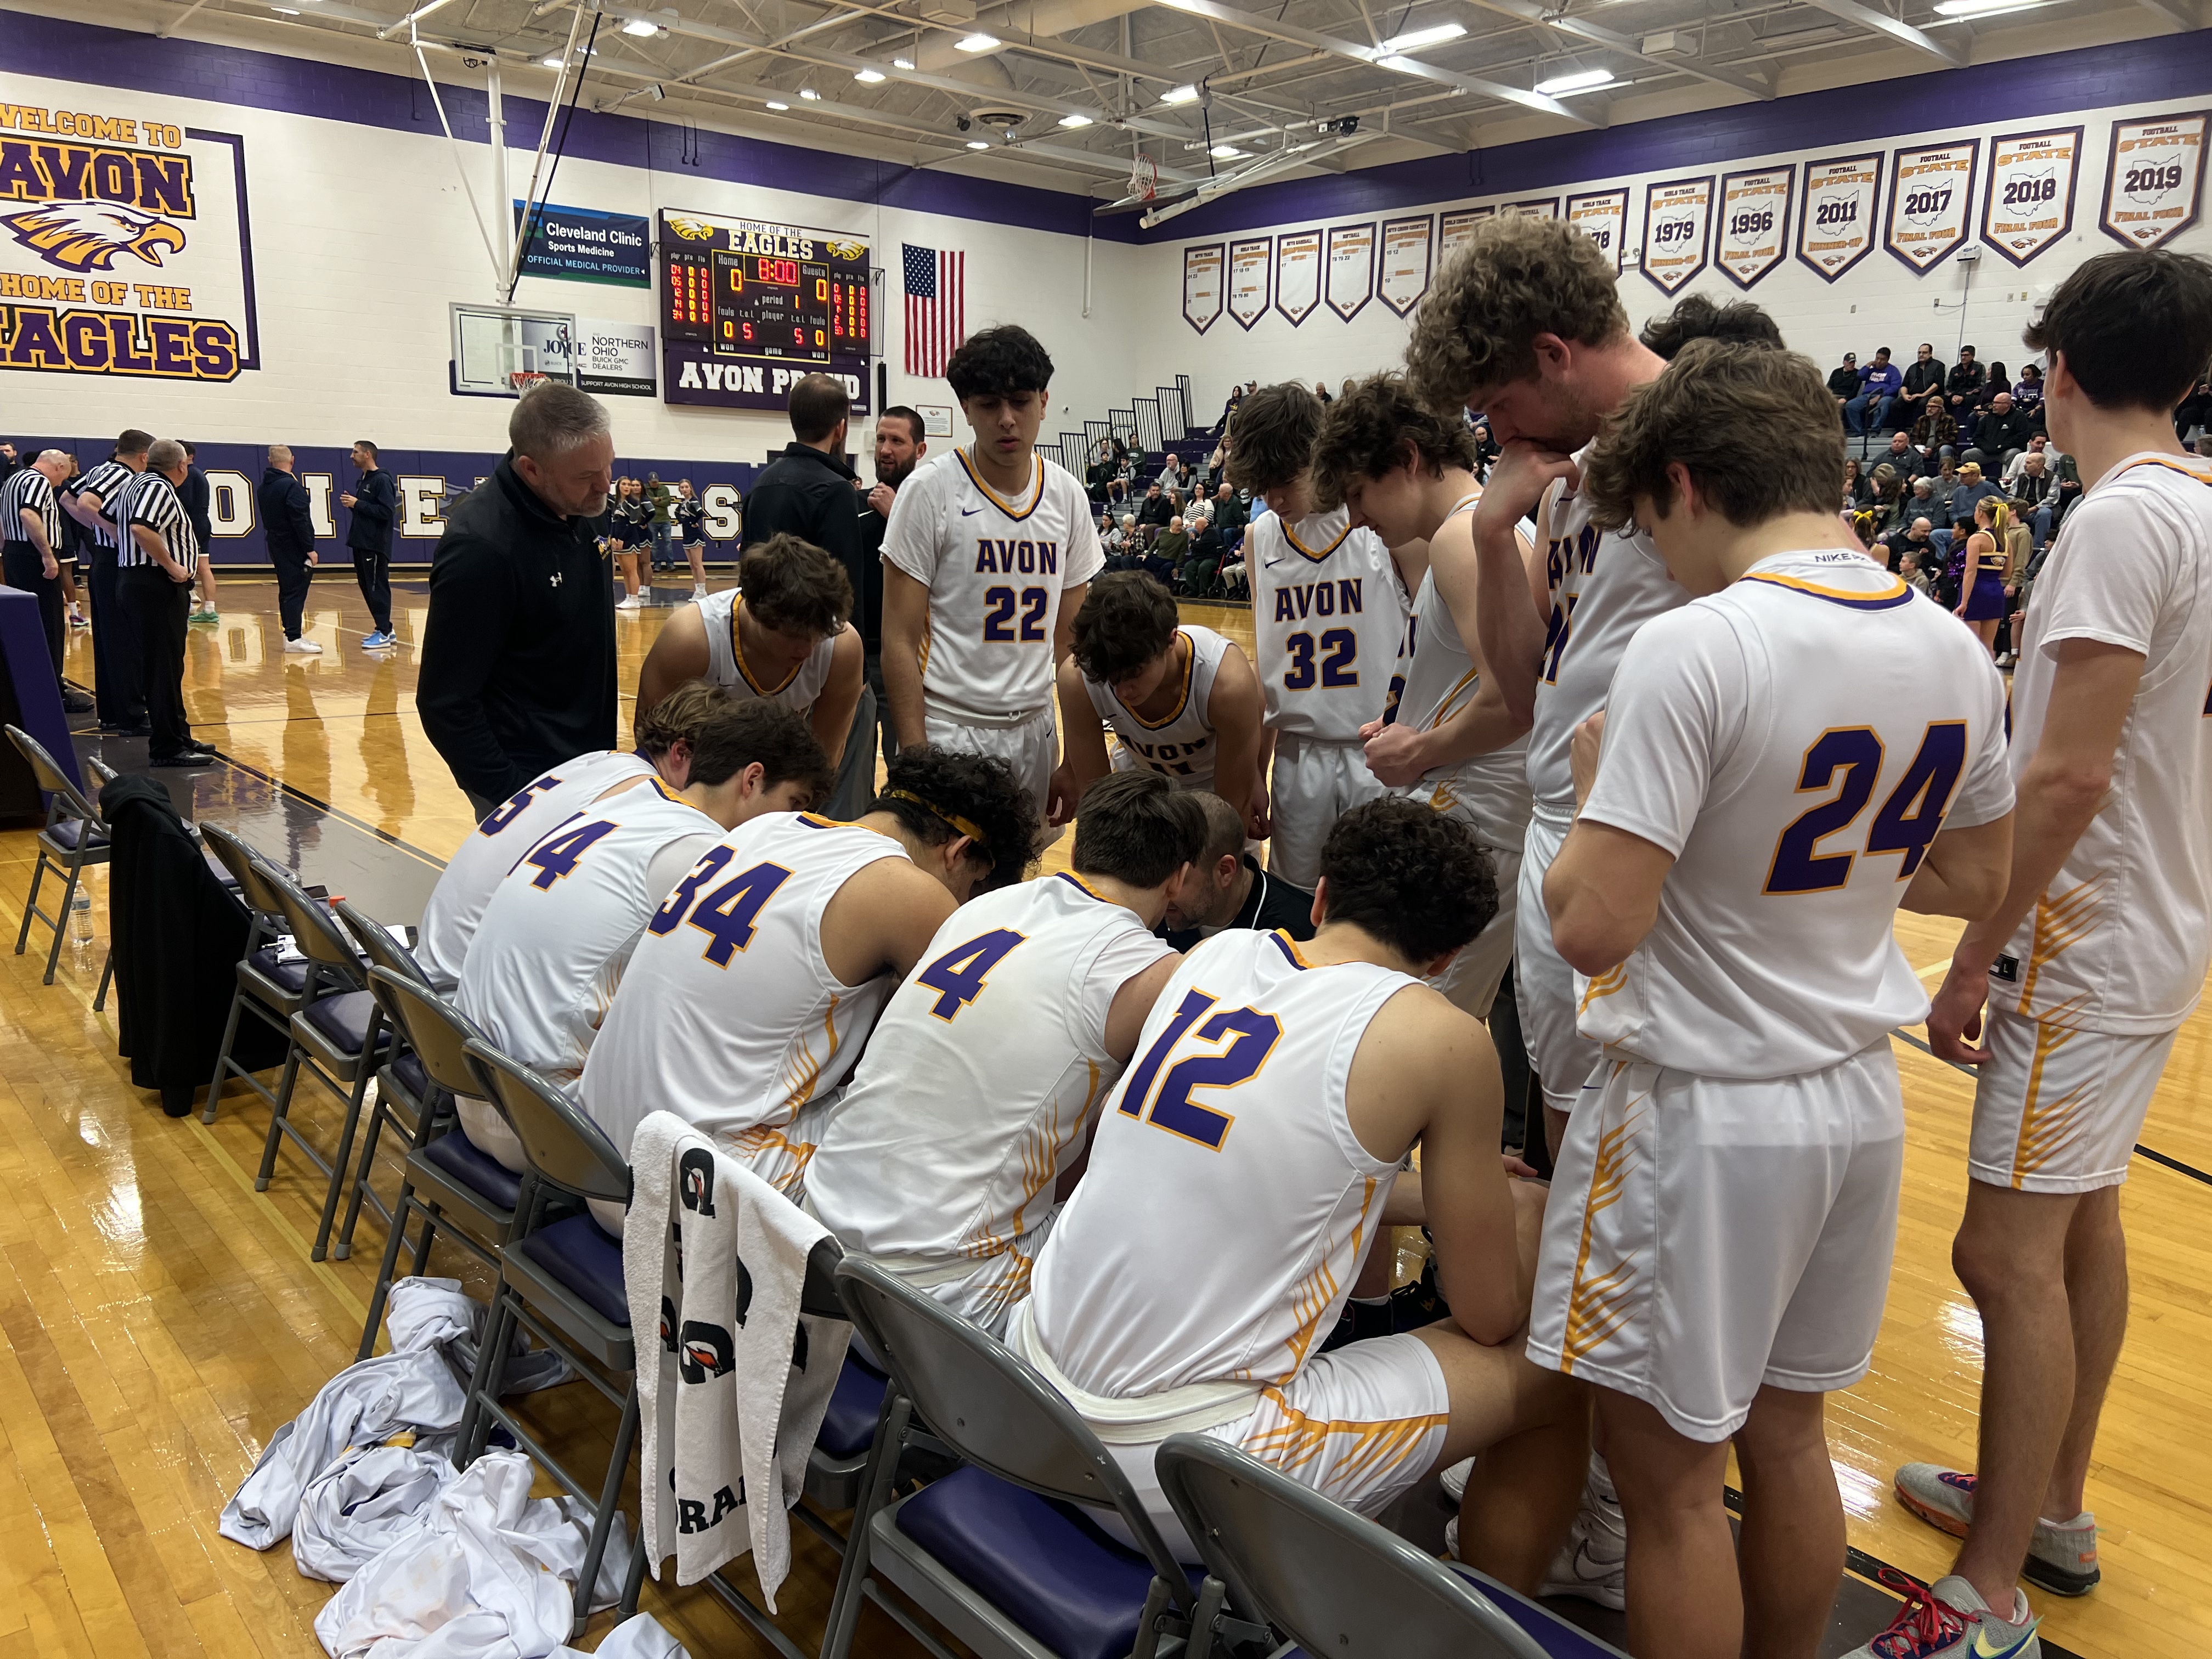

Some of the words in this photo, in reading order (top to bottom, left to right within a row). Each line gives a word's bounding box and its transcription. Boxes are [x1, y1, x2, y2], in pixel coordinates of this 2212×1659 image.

[0, 103, 137, 144] WELCOME
[143, 122, 182, 149] TO
[2142, 126, 2178, 136] FOOTBALL
[2019, 140, 2051, 150] FOOTBALL
[2119, 133, 2200, 153] STATE
[1920, 153, 1950, 162] FOOTBALL
[1997, 147, 2071, 167] STATE
[0, 135, 195, 218] AVON
[1829, 166, 1857, 174] FOOTBALL
[1900, 160, 1968, 178] STATE
[1744, 178, 1770, 187] FOOTBALL
[1810, 171, 1874, 190] STATE
[2124, 165, 2182, 193] 2019
[1728, 183, 1786, 201] STATE
[2003, 178, 2056, 205] 2018
[1652, 194, 1706, 210] STATE
[1905, 189, 1952, 216] 2017
[1570, 205, 1622, 221] STATE
[1816, 201, 1857, 225] 2011
[2114, 211, 2150, 223] FINAL
[2152, 206, 2183, 219] FOUR
[741, 221, 766, 233] HOME
[769, 225, 781, 234] OF
[784, 227, 802, 238] THE
[1655, 221, 1694, 243] 1979
[1730, 211, 1773, 235] 1996
[1994, 223, 2027, 234] FINAL
[2029, 217, 2058, 230] FOUR
[546, 222, 606, 242] Cleveland
[610, 230, 642, 246] Clinic
[1592, 231, 1610, 249] 78
[1897, 232, 1927, 242] FINAL
[1928, 227, 1956, 240] FOUR
[548, 241, 575, 252] Sports
[578, 244, 614, 257] Medicine
[729, 229, 813, 260] EAGLES
[527, 255, 563, 267] OFFICIAL
[566, 259, 600, 270] MEDICAL
[602, 264, 640, 274] PROVIDER
[718, 254, 738, 267] Home
[1724, 250, 1751, 261] FINAL
[671, 264, 682, 275] 04
[688, 266, 695, 277] 0
[701, 267, 708, 278] 0
[758, 257, 797, 284] 8:00
[802, 264, 825, 276] Guests
[689, 277, 695, 288] 0
[701, 279, 708, 289] 0
[730, 268, 742, 292] 0
[0, 273, 85, 303] HOME
[92, 281, 127, 305] OF
[134, 284, 191, 311] THE
[689, 288, 696, 299] 0
[702, 290, 708, 300] 0
[816, 279, 827, 301] 0
[849, 285, 855, 295] 0
[860, 286, 866, 296] 0
[689, 300, 696, 311] 0
[762, 296, 783, 305] period
[795, 295, 799, 309] 1
[849, 296, 855, 306] 0
[860, 297, 866, 306] 0
[673, 309, 684, 320] 34
[690, 311, 697, 323] 0
[702, 312, 709, 323] 0
[718, 306, 735, 317] fouls
[762, 310, 784, 321] player
[810, 315, 826, 326] fouls
[849, 306, 855, 316] 0
[860, 307, 866, 317] 0
[849, 317, 855, 326] 0
[860, 318, 866, 327] 0
[724, 321, 734, 338] 0
[742, 322, 753, 340] 5
[794, 328, 804, 345] 5
[815, 329, 825, 347] 0
[849, 326, 855, 337] 0
[860, 328, 866, 338] 0
[0, 305, 240, 382] AGLES
[592, 336, 648, 349] NORTHERN
[592, 346, 618, 357] OHIO
[720, 343, 734, 351] won
[765, 347, 782, 356] game
[679, 361, 764, 394] AVON
[974, 538, 1057, 575] AVON
[1815, 553, 1851, 562] NIKE
[1274, 577, 1363, 623] AVON
[983, 585, 1049, 643] 22
[1283, 627, 1360, 692] 32
[1760, 719, 1968, 896] 24
[505, 810, 623, 893] 4
[646, 843, 796, 970] 34
[913, 926, 1030, 1024] 4
[2004, 963, 2008, 973] L
[1116, 985, 1284, 1153] 12
